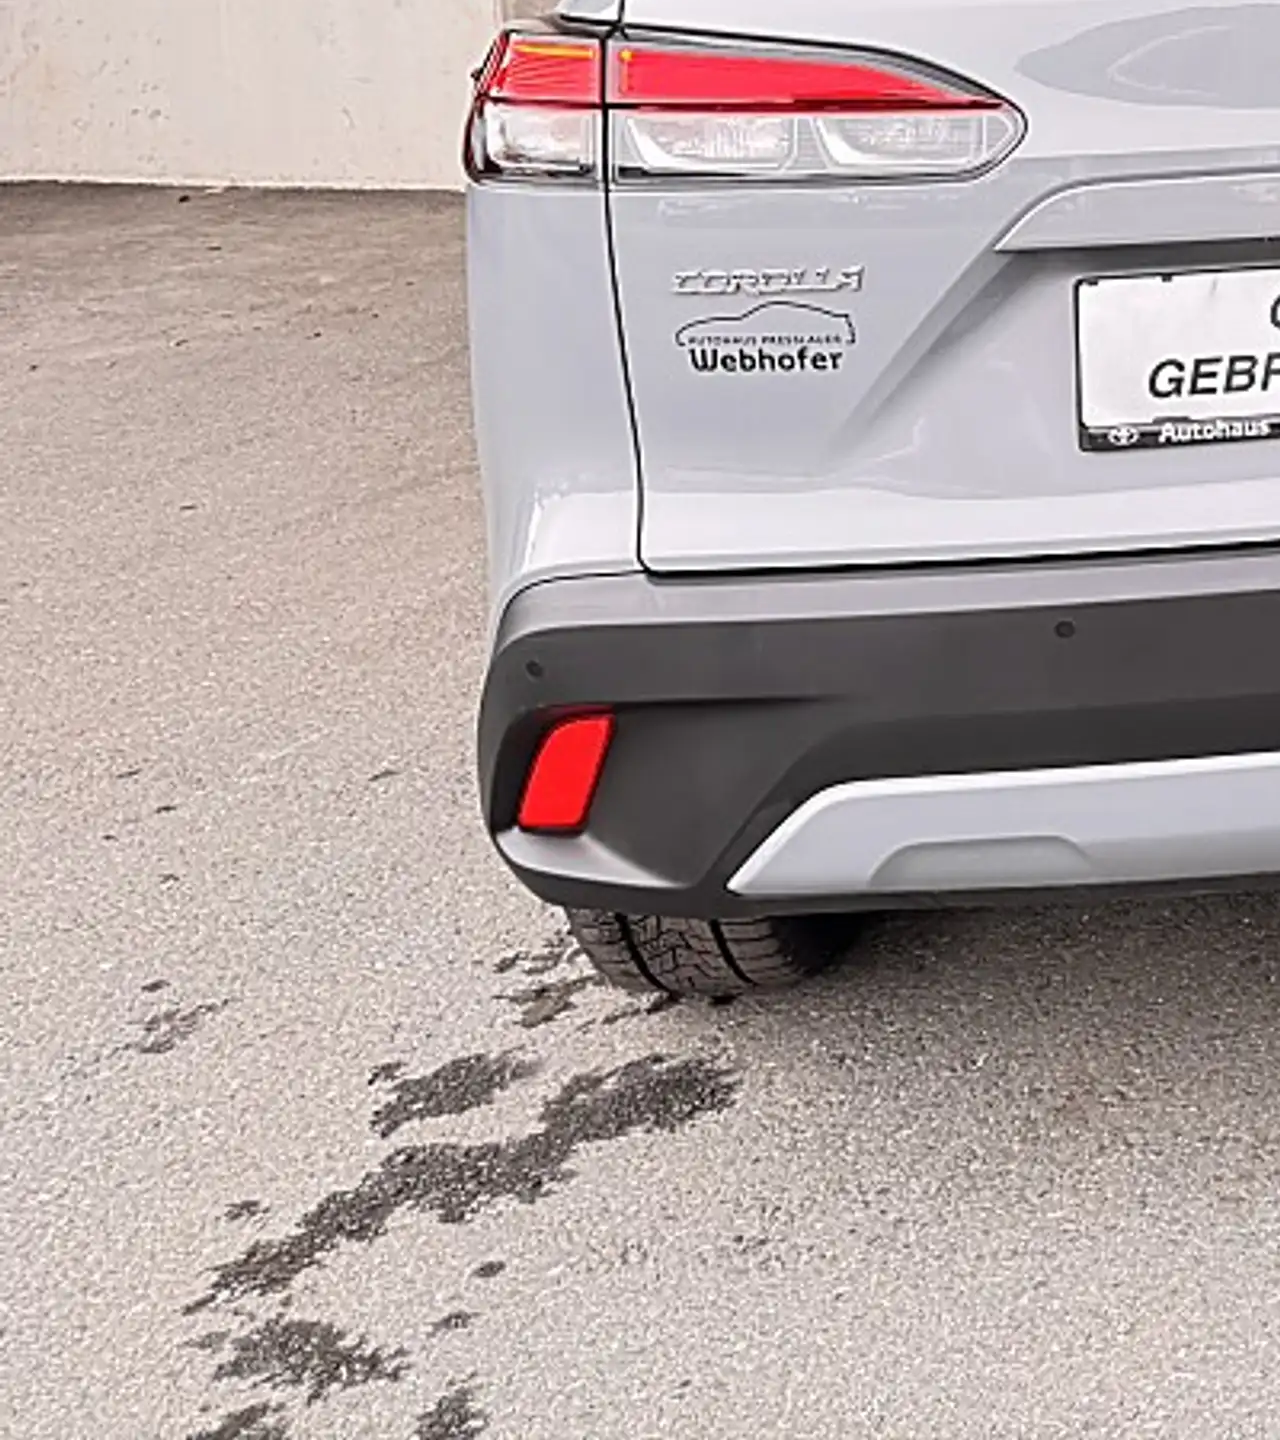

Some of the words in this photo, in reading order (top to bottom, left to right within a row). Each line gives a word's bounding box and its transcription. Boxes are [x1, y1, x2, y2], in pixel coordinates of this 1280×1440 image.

[672, 264, 866, 296] COROLLA
[688, 345, 843, 372] Webhofer
[1158, 418, 1270, 444] Autohaus
